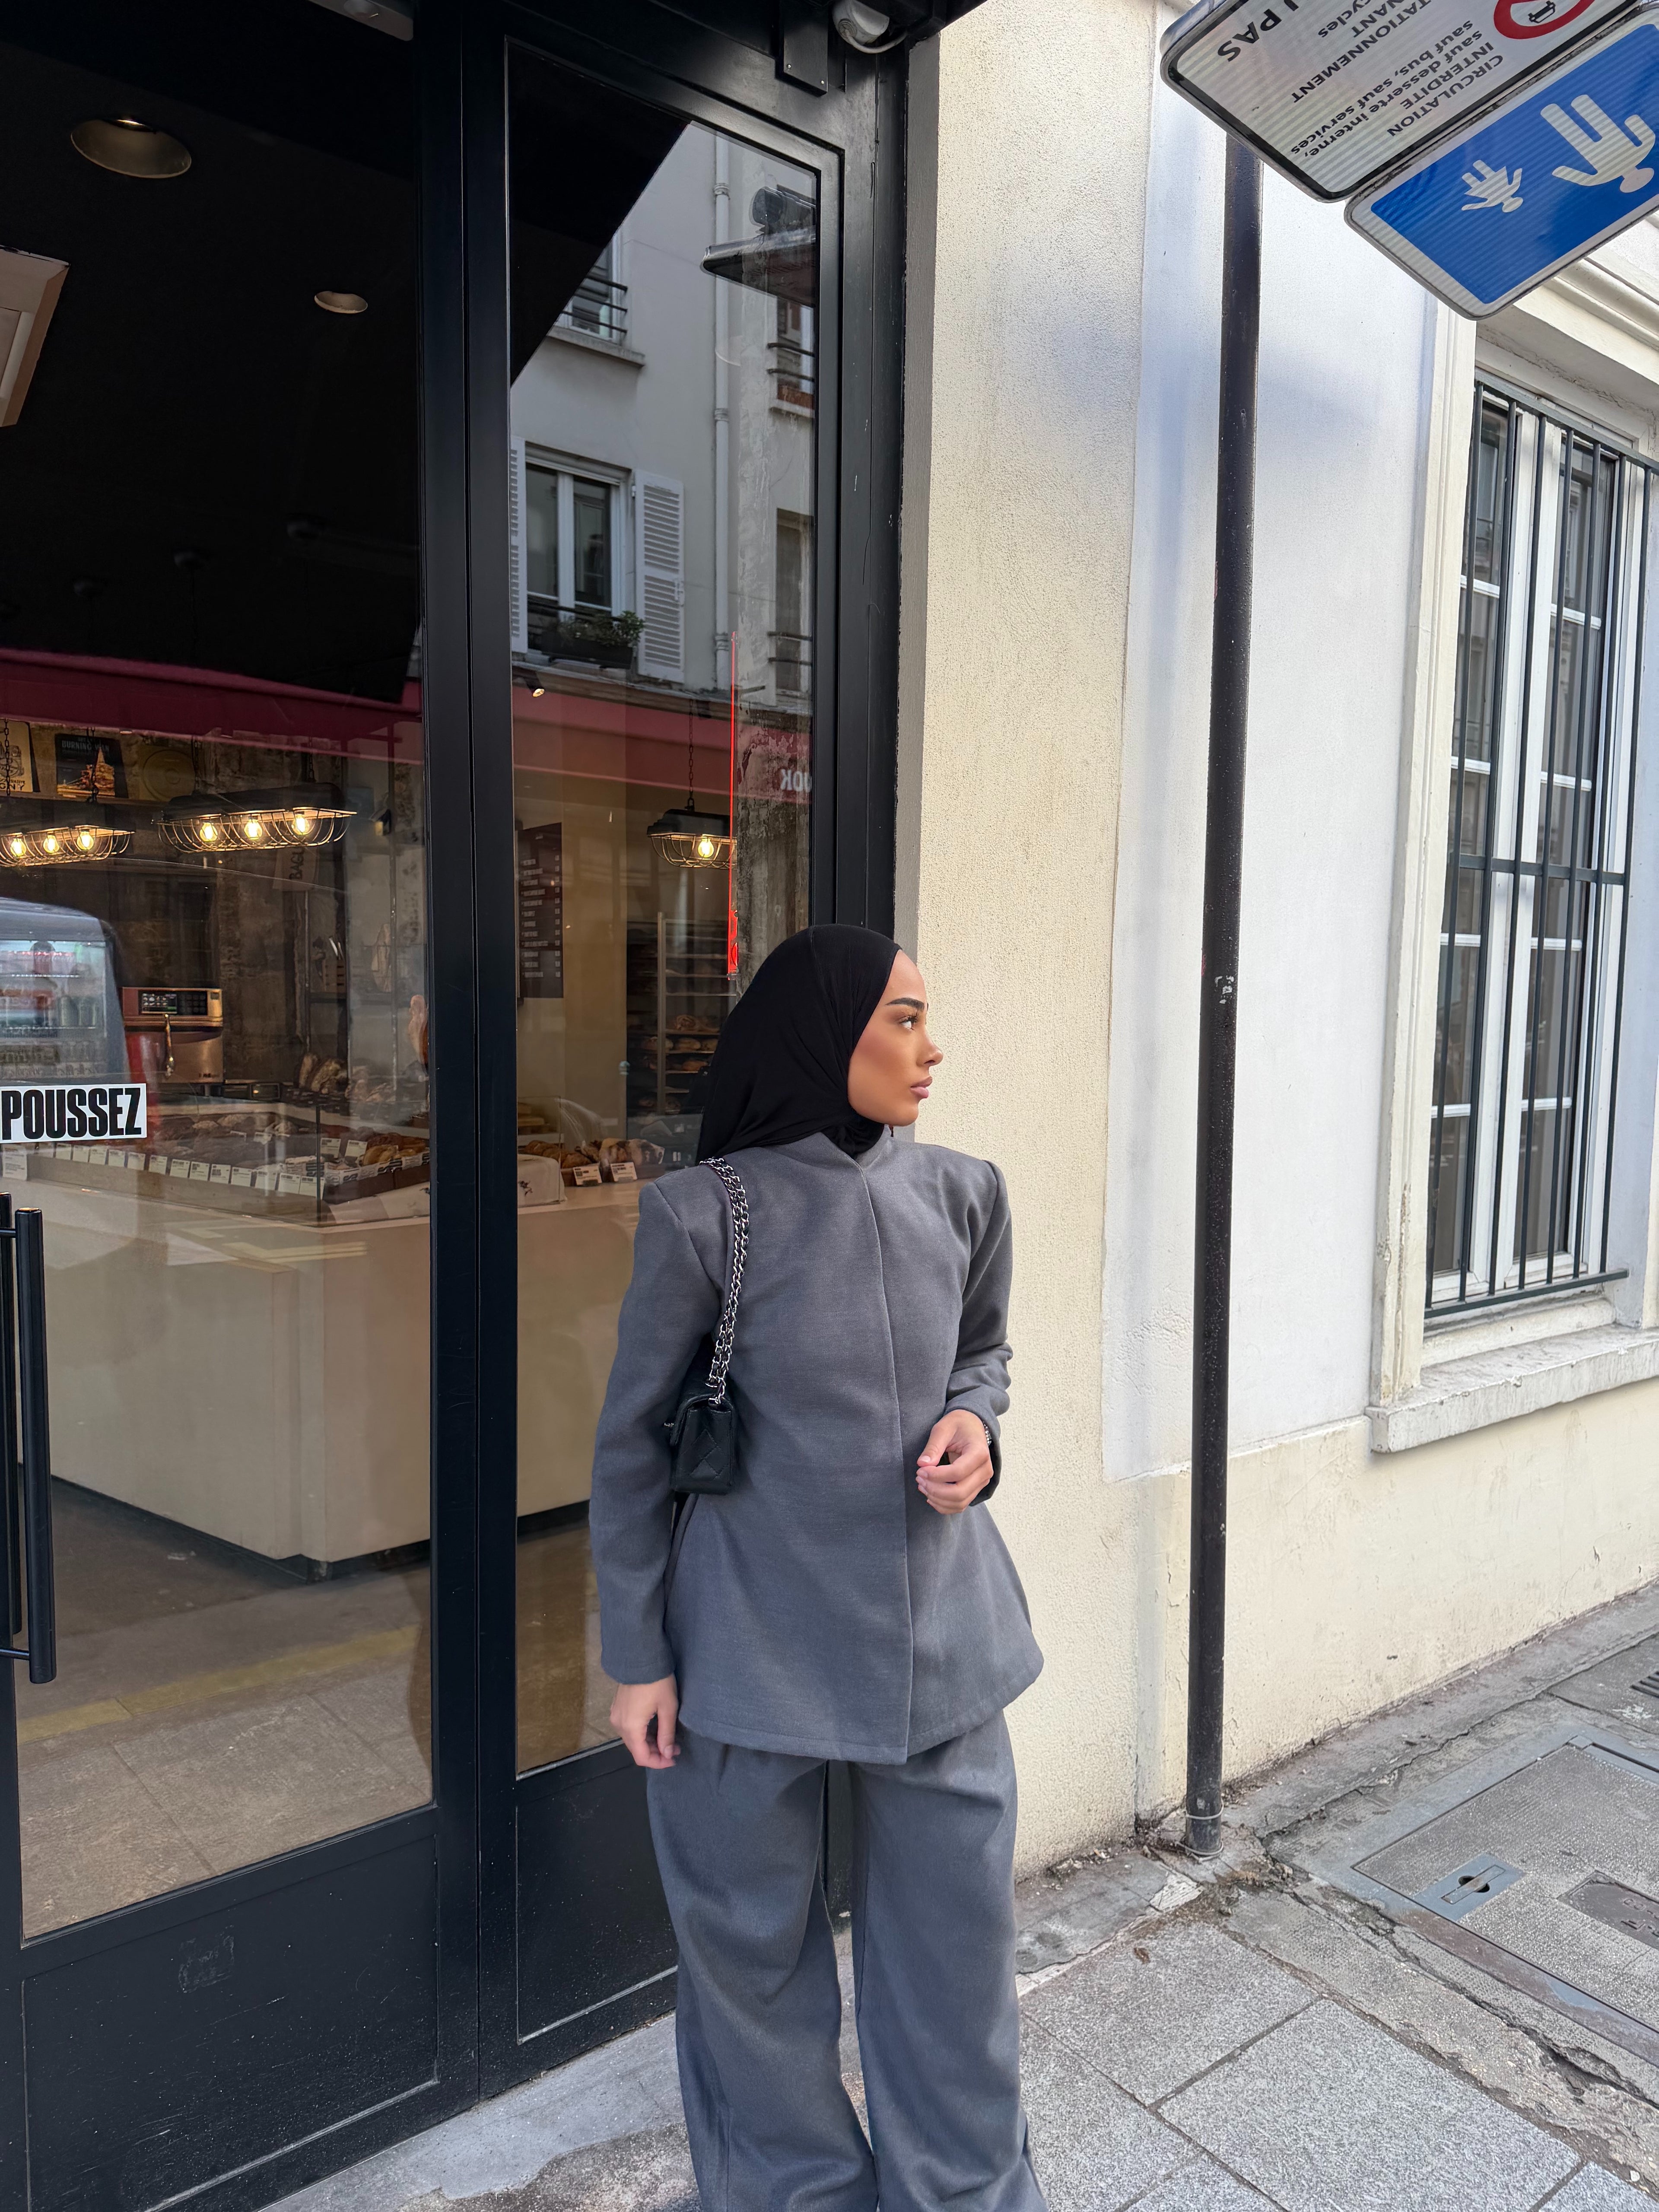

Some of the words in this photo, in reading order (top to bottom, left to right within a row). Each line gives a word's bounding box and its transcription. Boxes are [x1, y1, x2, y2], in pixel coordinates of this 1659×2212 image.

[1217, 9, 1282, 62] PAS
[1434, 20, 1473, 54] sauf
[1444, 31, 1482, 64] sauf
[1369, 60, 1441, 113] desserte
[1395, 50, 1434, 76] bus,
[1400, 42, 1494, 109] INTERDITE
[1357, 78, 1392, 109] sauf
[1387, 55, 1503, 137] CIRCULATION
[1291, 105, 1355, 154] services
[1305, 113, 1369, 157] interne,
[1, 1087, 142, 1140] POUSSEZ
